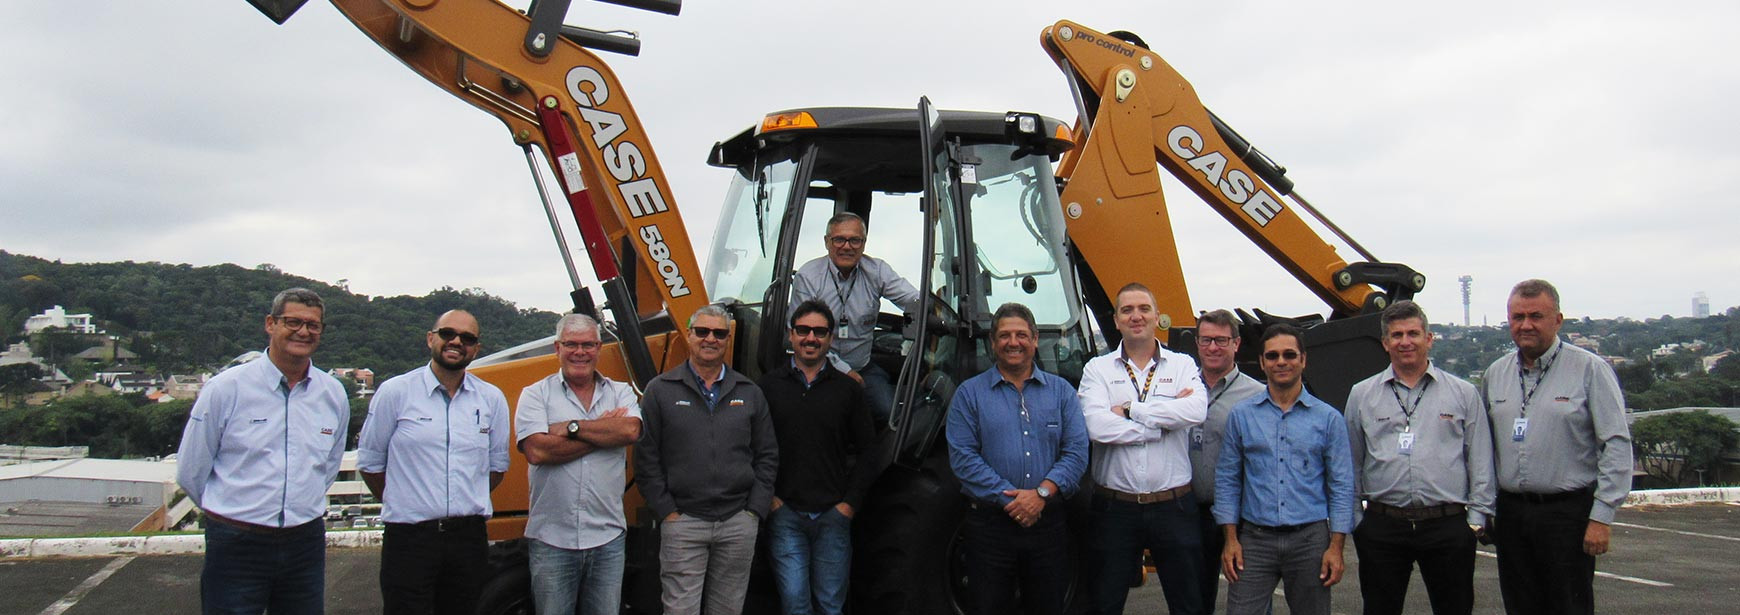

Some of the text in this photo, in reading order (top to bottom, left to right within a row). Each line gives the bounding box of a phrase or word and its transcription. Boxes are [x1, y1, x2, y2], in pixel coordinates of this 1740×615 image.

[1075, 31, 1136, 58] pro control
[565, 65, 691, 298] CASE 580N
[1167, 125, 1284, 228] CASE
